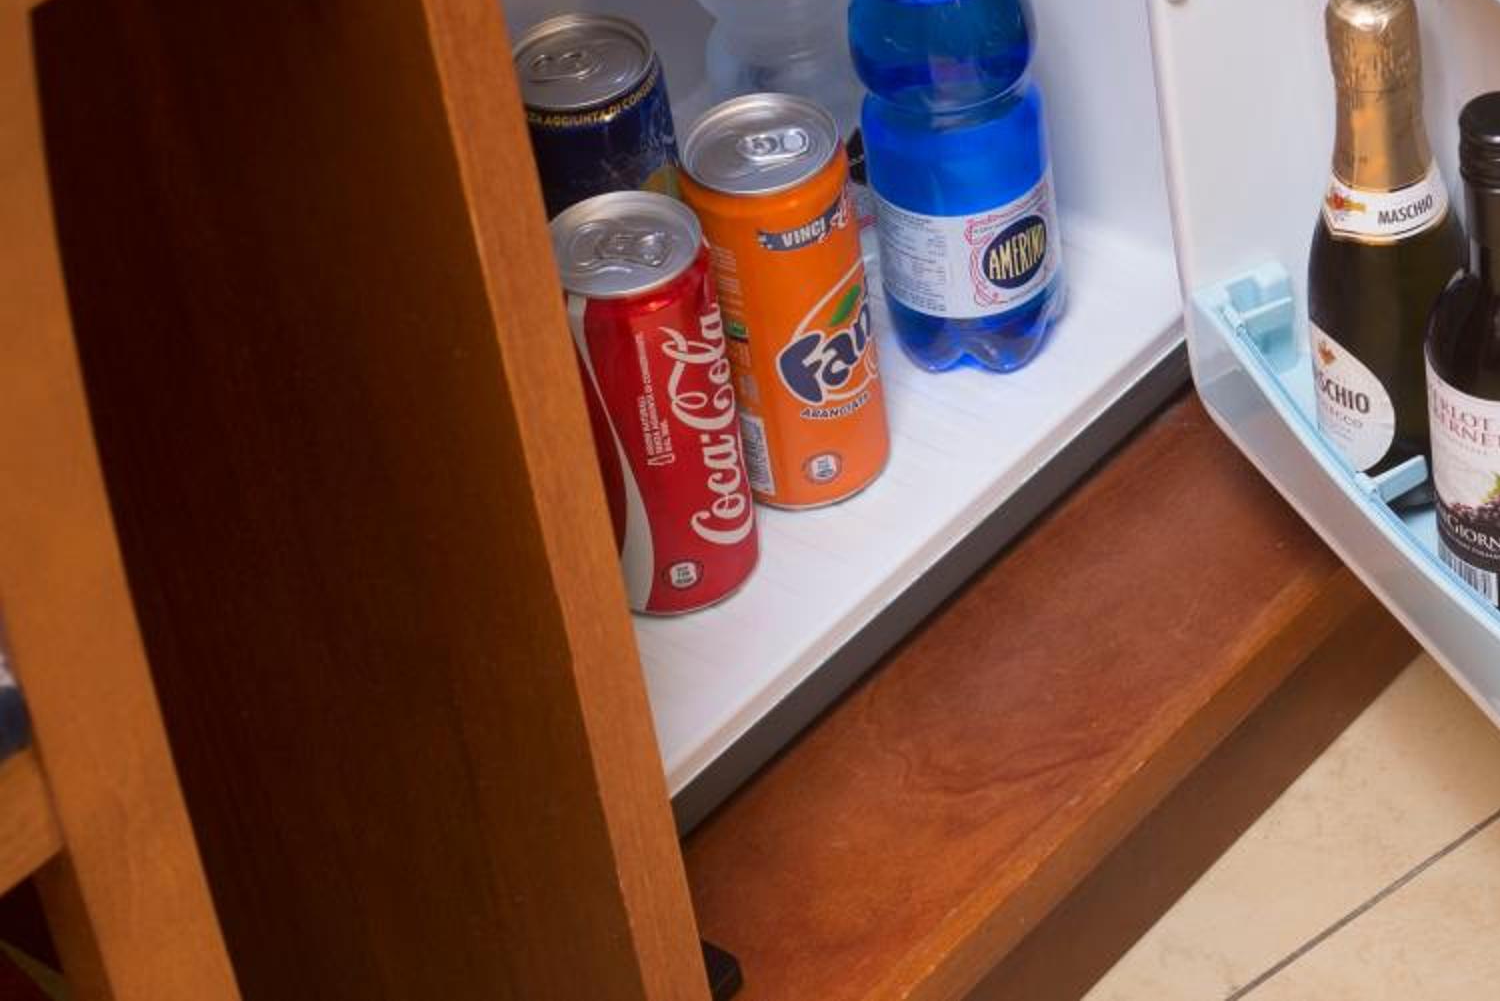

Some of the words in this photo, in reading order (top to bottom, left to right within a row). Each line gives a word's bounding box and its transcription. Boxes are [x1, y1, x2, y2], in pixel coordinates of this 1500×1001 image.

[1377, 193, 1434, 226] MASCHIO
[781, 216, 827, 249] VINCI
[659, 302, 752, 545] Coca-Cola
